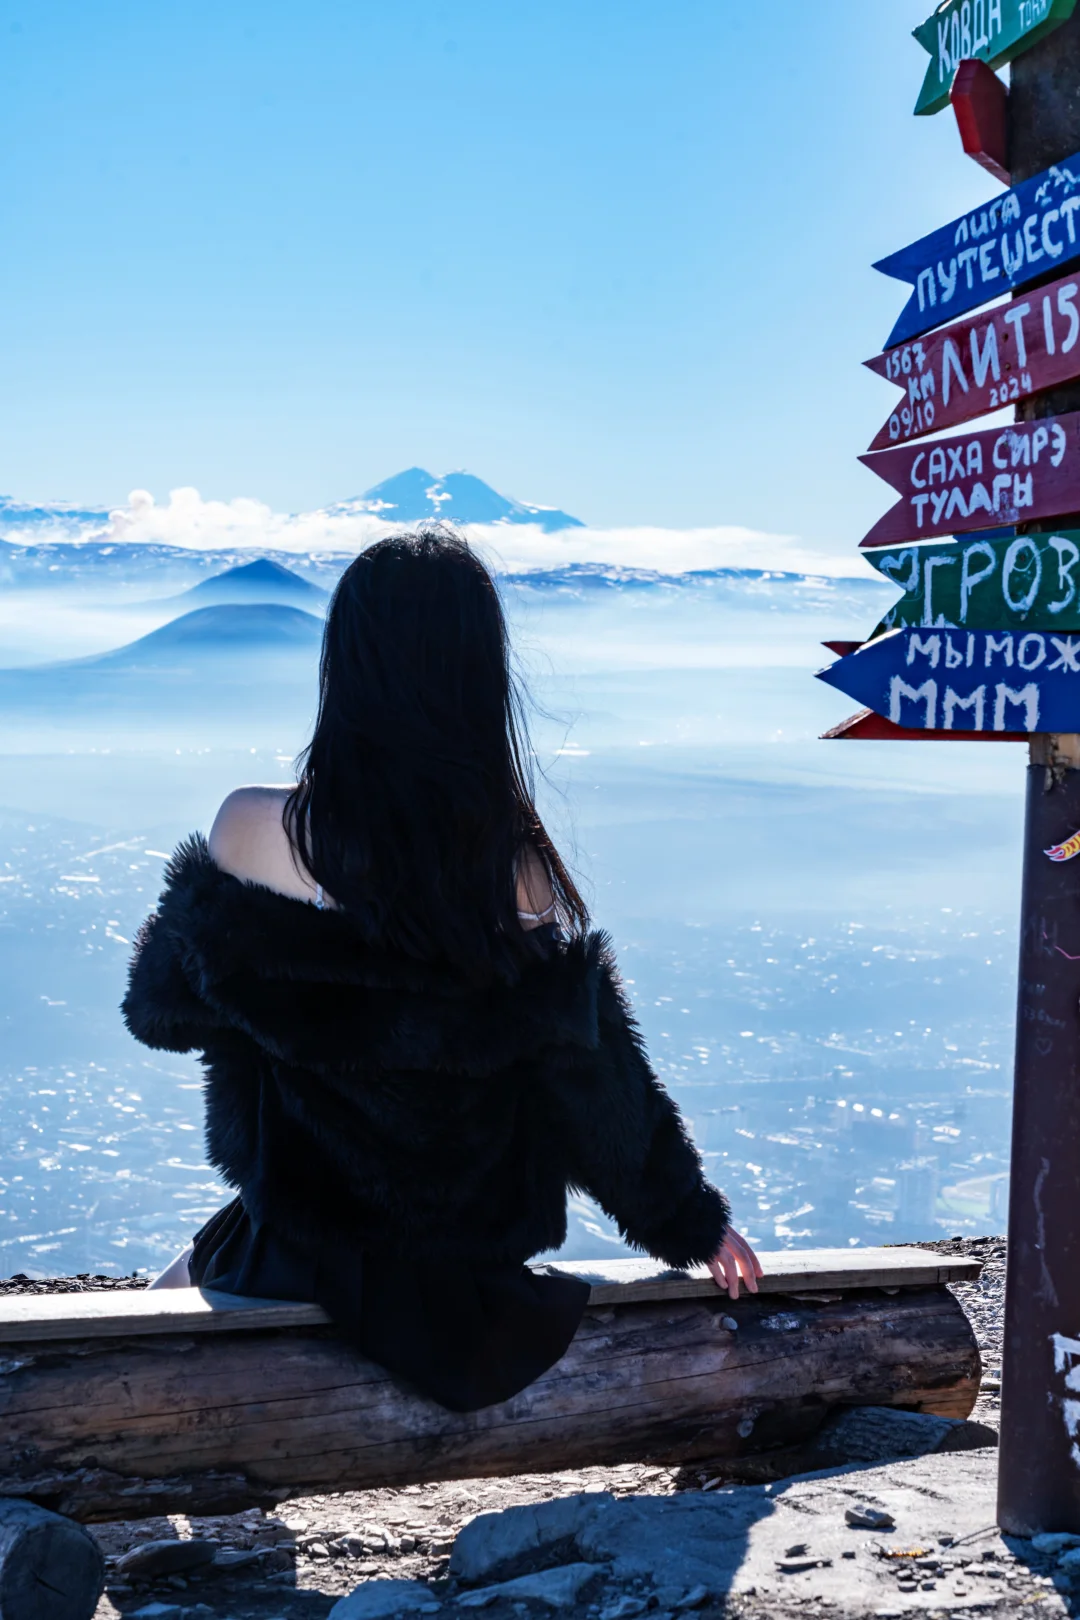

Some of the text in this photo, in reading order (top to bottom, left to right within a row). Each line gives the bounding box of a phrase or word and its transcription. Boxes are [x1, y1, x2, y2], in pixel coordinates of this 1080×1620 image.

[886, 342, 926, 379] 1567
[989, 372, 1033, 407] 2024
[910, 423, 1066, 489] САХА СИРЭ
[888, 675, 1041, 733] МММ
